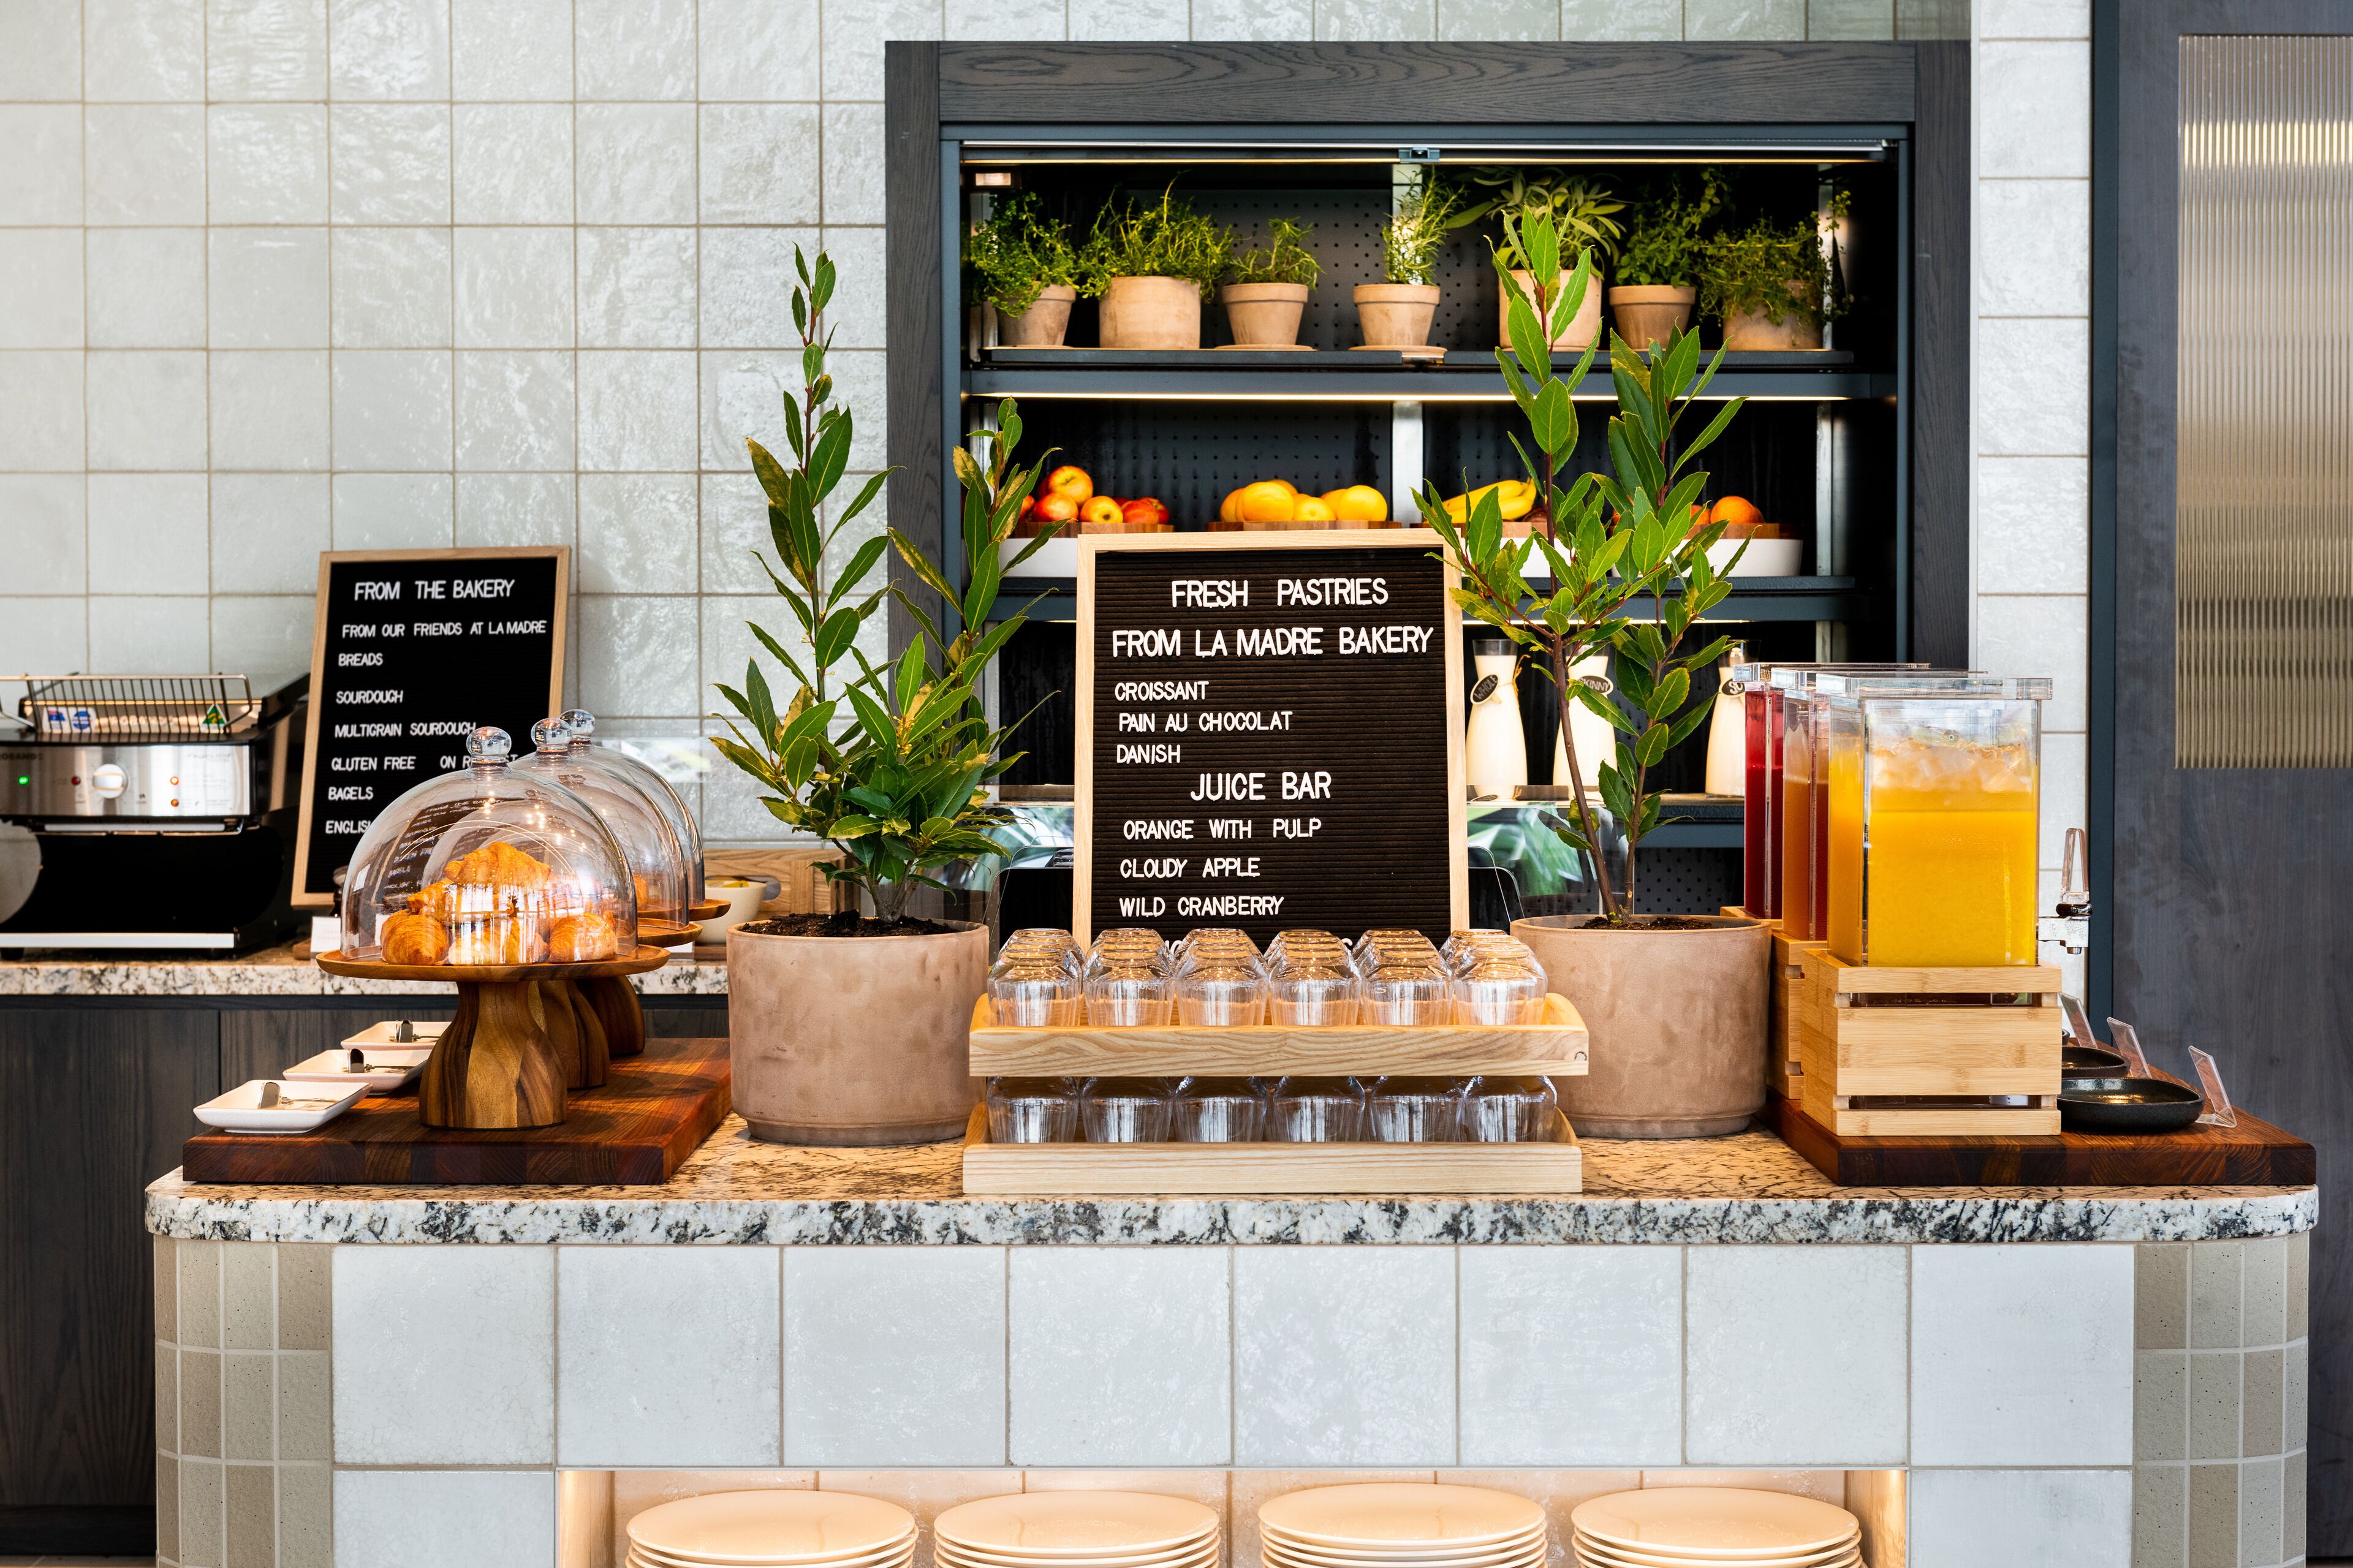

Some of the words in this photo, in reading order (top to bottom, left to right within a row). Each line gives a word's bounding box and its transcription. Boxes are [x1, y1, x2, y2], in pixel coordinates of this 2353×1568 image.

[354, 581, 401, 601] FROM
[414, 580, 447, 599] THE
[452, 578, 515, 599] BAKERY
[1171, 580, 1248, 608] FRESH
[1276, 577, 1389, 607] PASTRIES
[342, 624, 376, 638] FROM
[381, 623, 406, 637] OUR
[414, 622, 463, 637] FRIENDS
[469, 622, 484, 635] AT
[488, 621, 504, 635] LA
[506, 619, 547, 635] MADRE
[1112, 629, 1181, 657] FROM
[1195, 629, 1228, 658] LA
[1237, 627, 1324, 657] MADRE
[1339, 626, 1434, 655] BAKERY
[338, 653, 384, 667] BREADS
[336, 689, 404, 704] SOURDOUGH
[1114, 680, 1210, 702] CROISSANT
[1474, 675, 1498, 699] WHOLE
[1728, 681, 1743, 695] SO
[335, 723, 402, 738] MULTIGRAIN
[409, 722, 476, 737] SOURDOUGH
[1119, 713, 1156, 733] PAIN
[1164, 713, 1188, 733] AU
[1199, 711, 1294, 732] CHOCOLAT
[331, 757, 377, 771] GLUTEN
[384, 756, 417, 770] FREE
[440, 755, 457, 769] ON
[1116, 744, 1181, 765] DANISH
[328, 786, 374, 801] BAGELS
[1190, 772, 1266, 801] JUICE
[1281, 771, 1332, 800] BAR
[325, 820, 371, 835] ENGLIS
[1123, 819, 1194, 840] ORANGE
[1208, 819, 1252, 839] WITH
[1273, 817, 1322, 839] PULP
[1120, 858, 1188, 879] CLOUDY
[1202, 857, 1260, 879] APPLE
[1119, 896, 1166, 918] WILD
[1177, 895, 1284, 917] CRANBERRY
